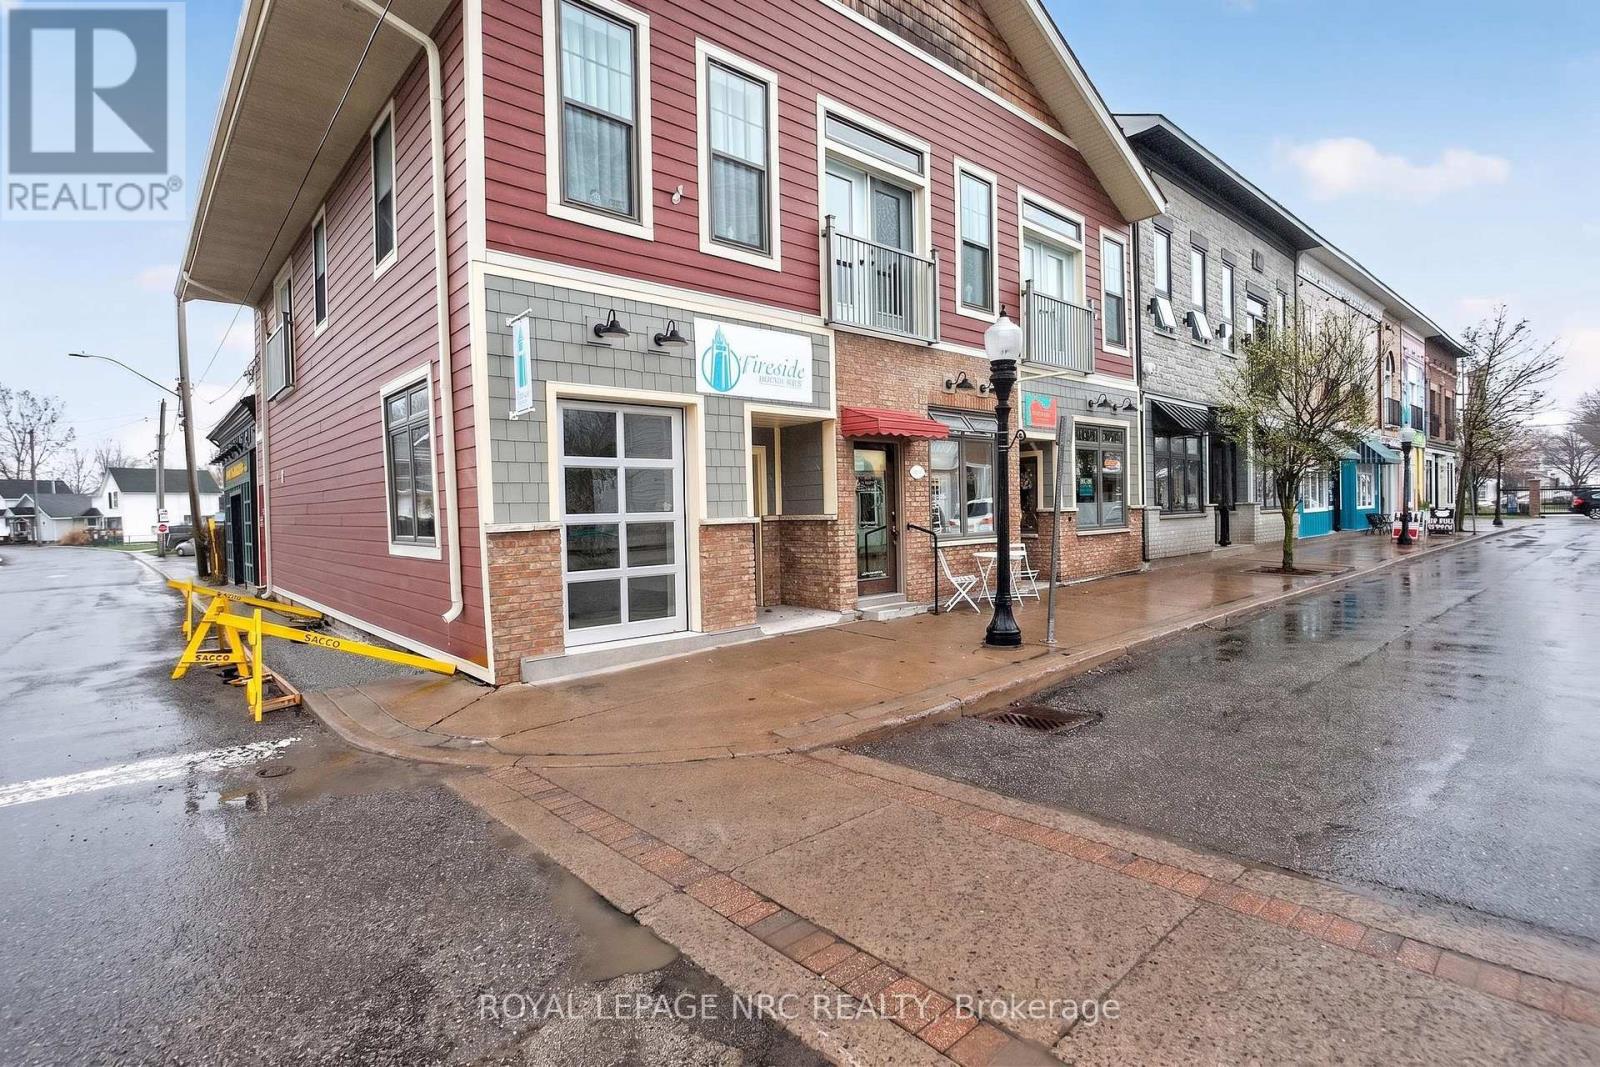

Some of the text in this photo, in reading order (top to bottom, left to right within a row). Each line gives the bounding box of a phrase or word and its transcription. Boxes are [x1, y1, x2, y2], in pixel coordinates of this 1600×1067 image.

[739, 354, 805, 380] Fireside
[304, 633, 341, 648] SACCO
[195, 654, 230, 662] SACCO
